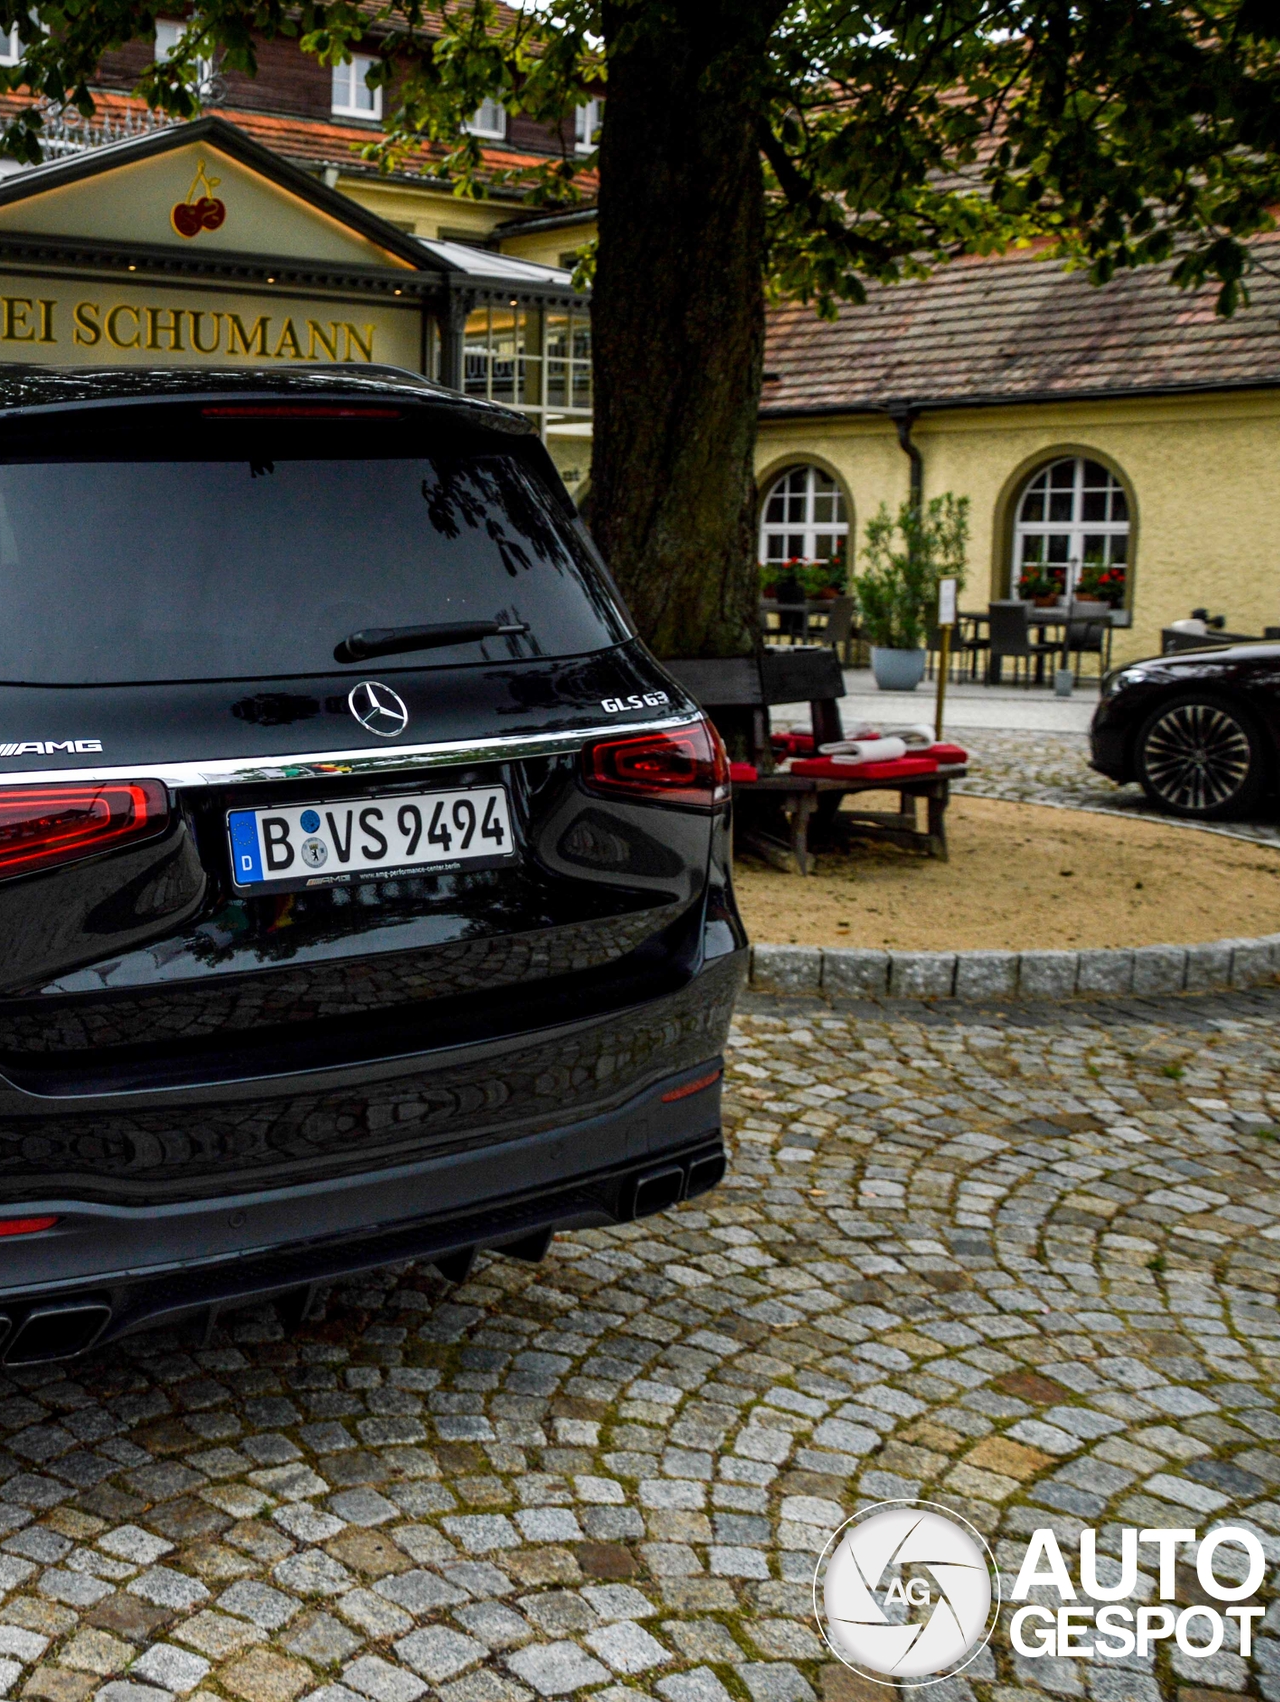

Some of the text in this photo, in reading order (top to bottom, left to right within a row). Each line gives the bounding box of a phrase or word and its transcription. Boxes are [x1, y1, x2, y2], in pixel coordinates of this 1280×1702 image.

[72, 301, 377, 362] SCHUMANN
[601, 691, 670, 713] GLS 63
[17, 739, 103, 755] AMG
[262, 816, 295, 871] B
[325, 807, 388, 863] VS
[397, 796, 505, 856] 9494
[242, 855, 253, 871] D
[359, 862, 461, 879] www.amg-performance-center.berlin
